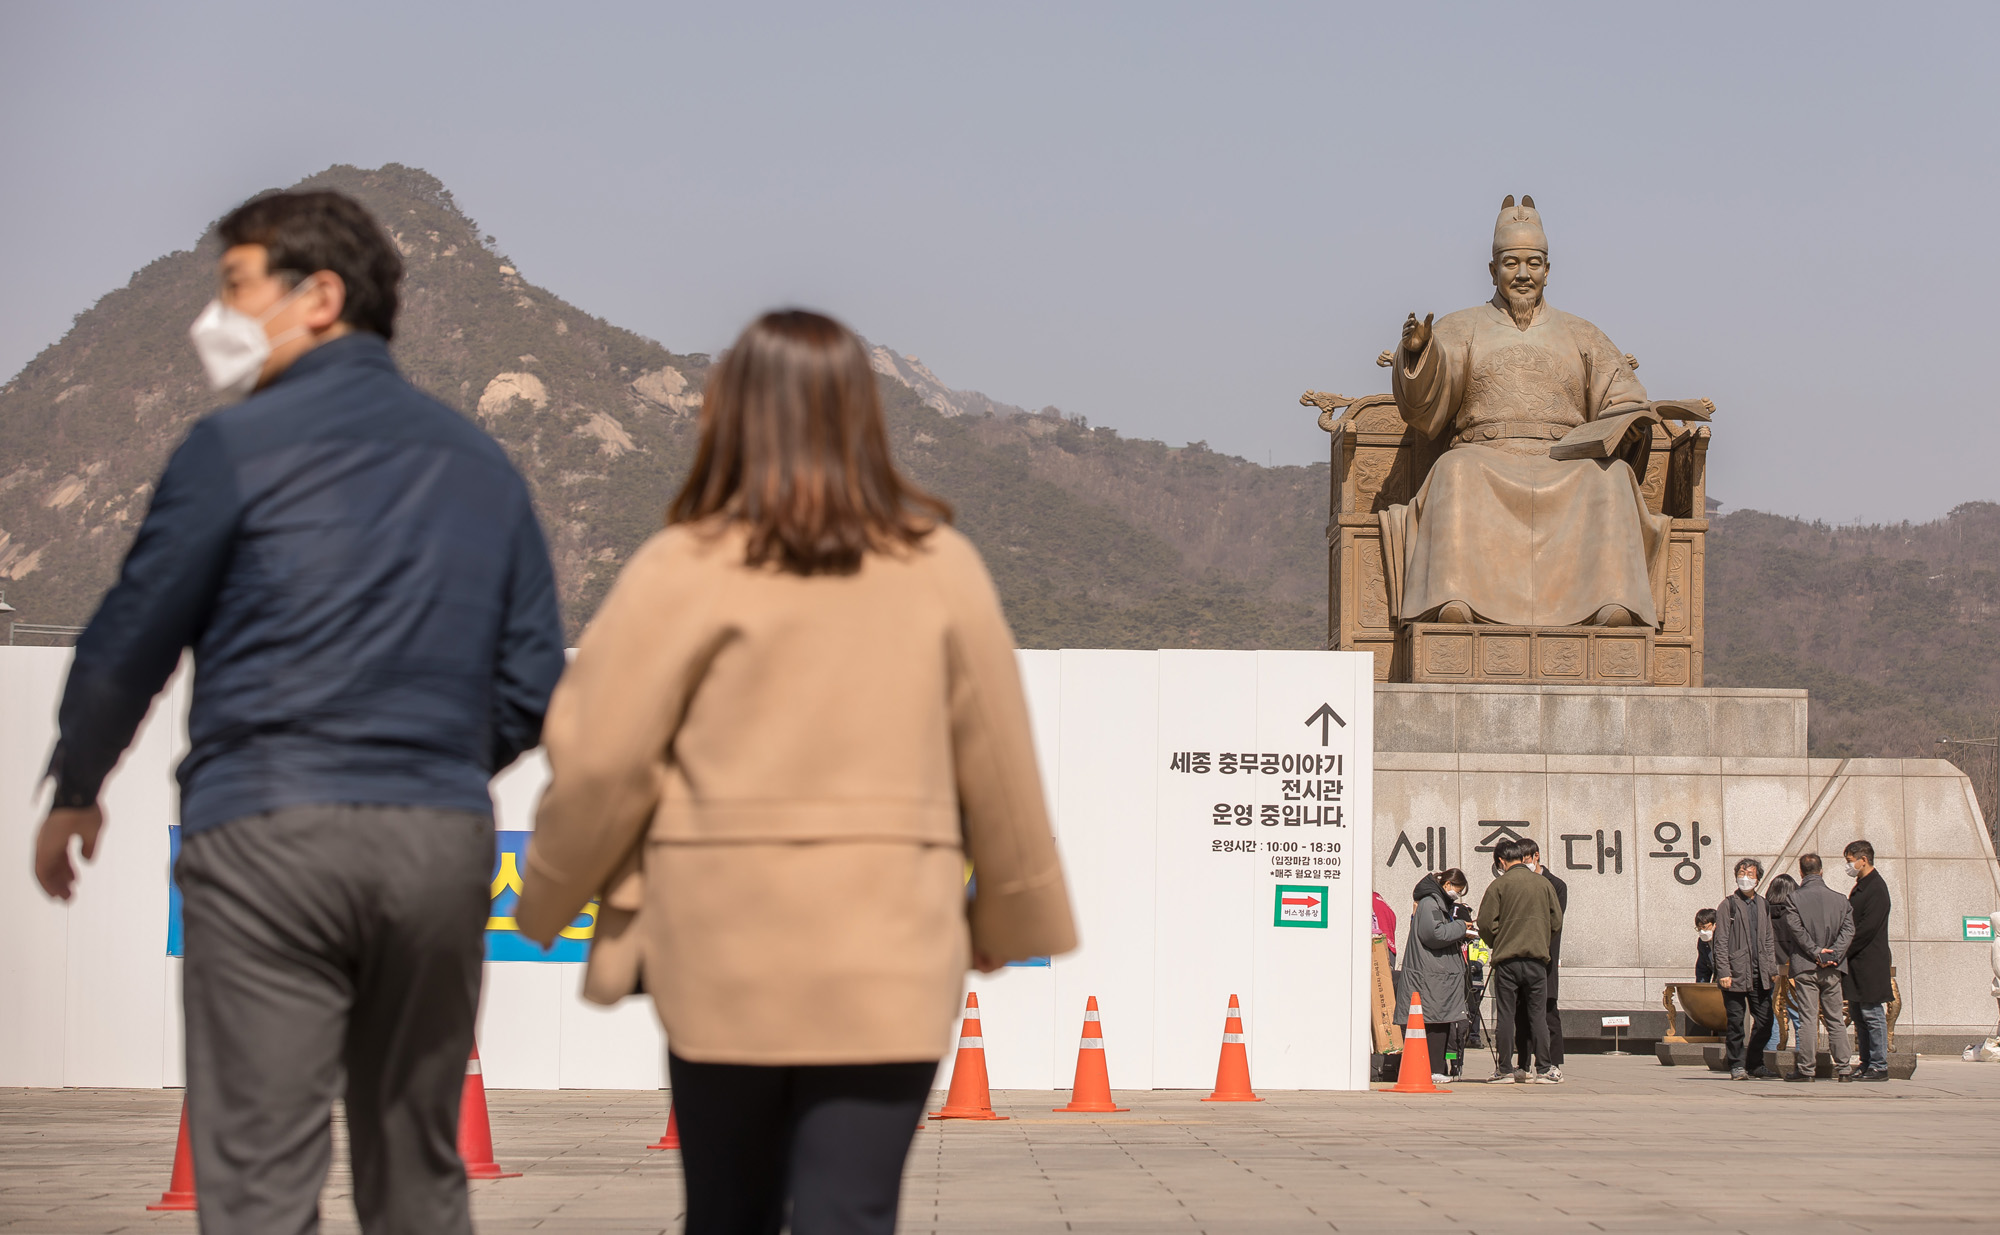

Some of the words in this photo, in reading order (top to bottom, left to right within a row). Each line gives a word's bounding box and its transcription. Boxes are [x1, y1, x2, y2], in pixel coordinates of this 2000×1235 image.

[1169, 752, 1212, 774] 세종
[1218, 752, 1343, 776] 충무공이야기
[1281, 779, 1344, 801] 전시관
[1212, 803, 1253, 827] 운영
[1259, 804, 1347, 829] 중입니다.
[1211, 840, 1258, 853] 운영시간
[1266, 841, 1299, 852] 10:00
[1309, 842, 1342, 853] 18:30
[1271, 856, 1311, 866] (입장마감
[1313, 857, 1342, 867] 18:00)
[1295, 869, 1321, 880] 월요일
[1323, 869, 1342, 880] 휴관
[1284, 909, 1319, 917] 버스정류장
